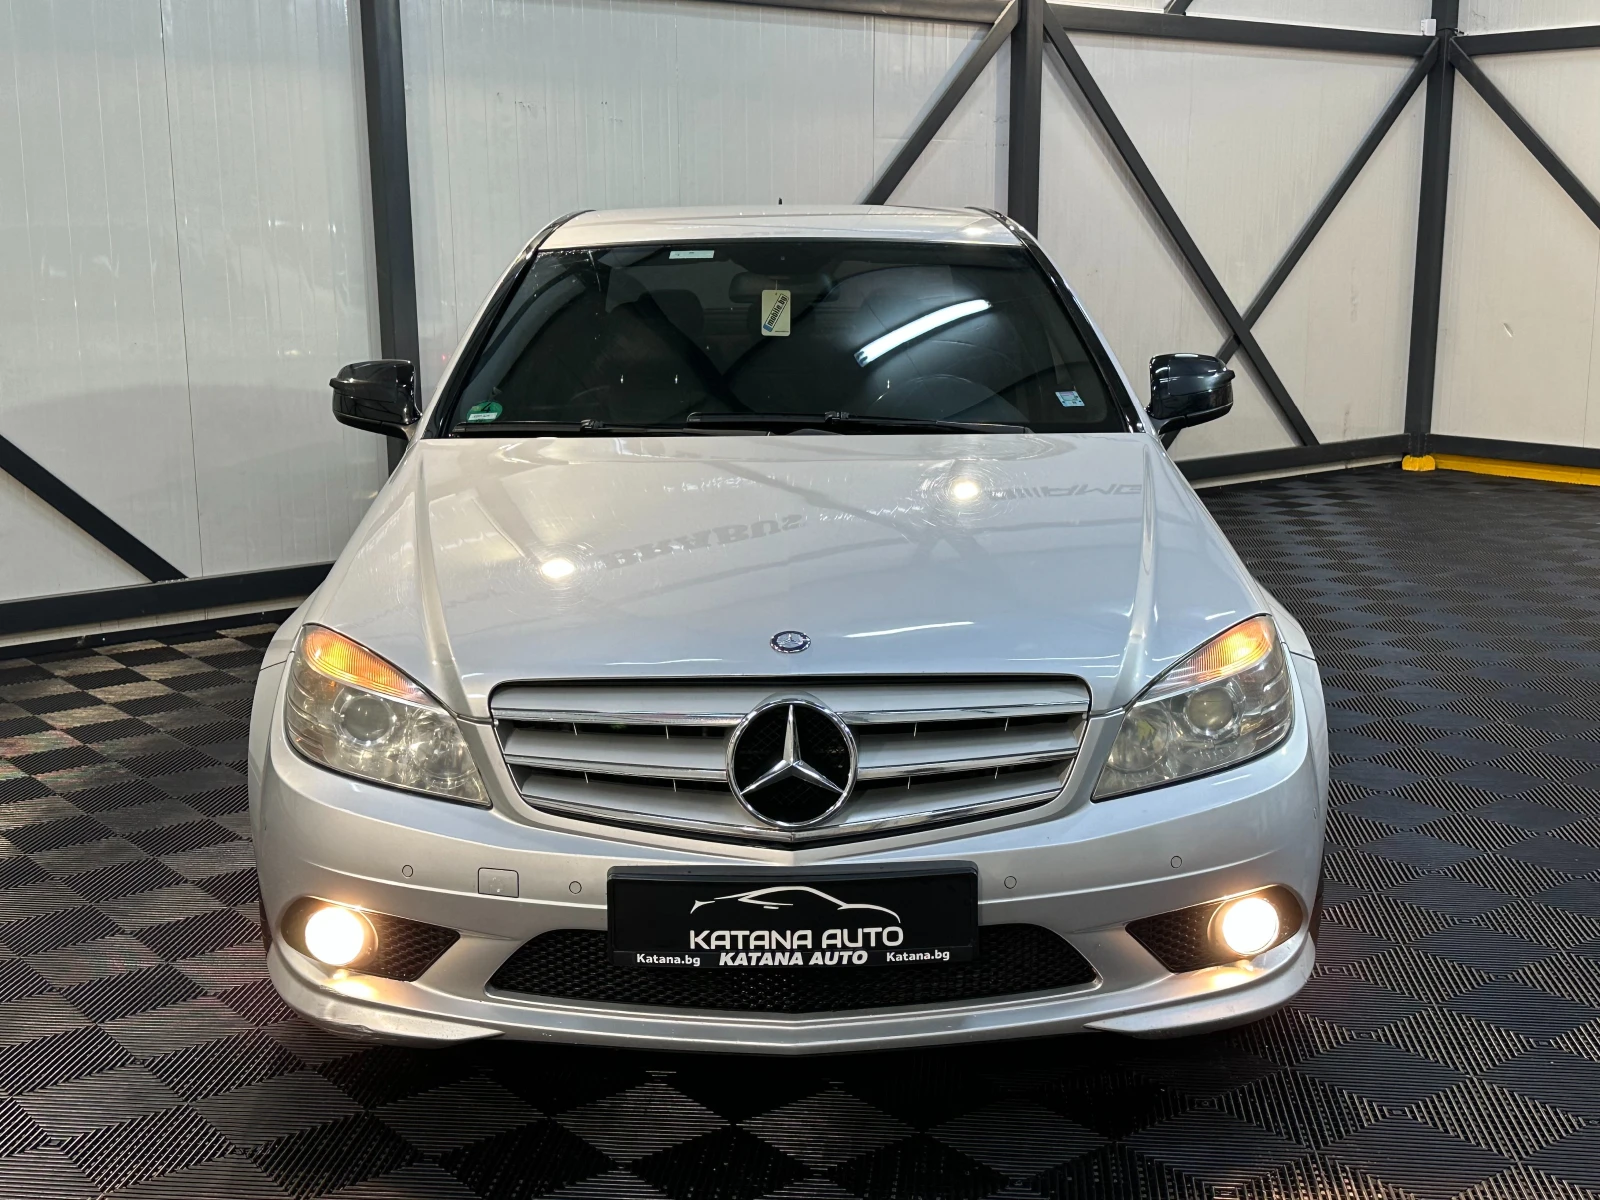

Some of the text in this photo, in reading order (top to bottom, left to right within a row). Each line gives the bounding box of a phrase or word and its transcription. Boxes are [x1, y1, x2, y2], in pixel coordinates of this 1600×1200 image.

[480, 402, 491, 413] 4
[689, 926, 904, 950] KATANA AUTO
[636, 953, 701, 967] Katana.bg
[719, 950, 868, 966] KATANA AUTO
[886, 949, 950, 962] Katana.bg
